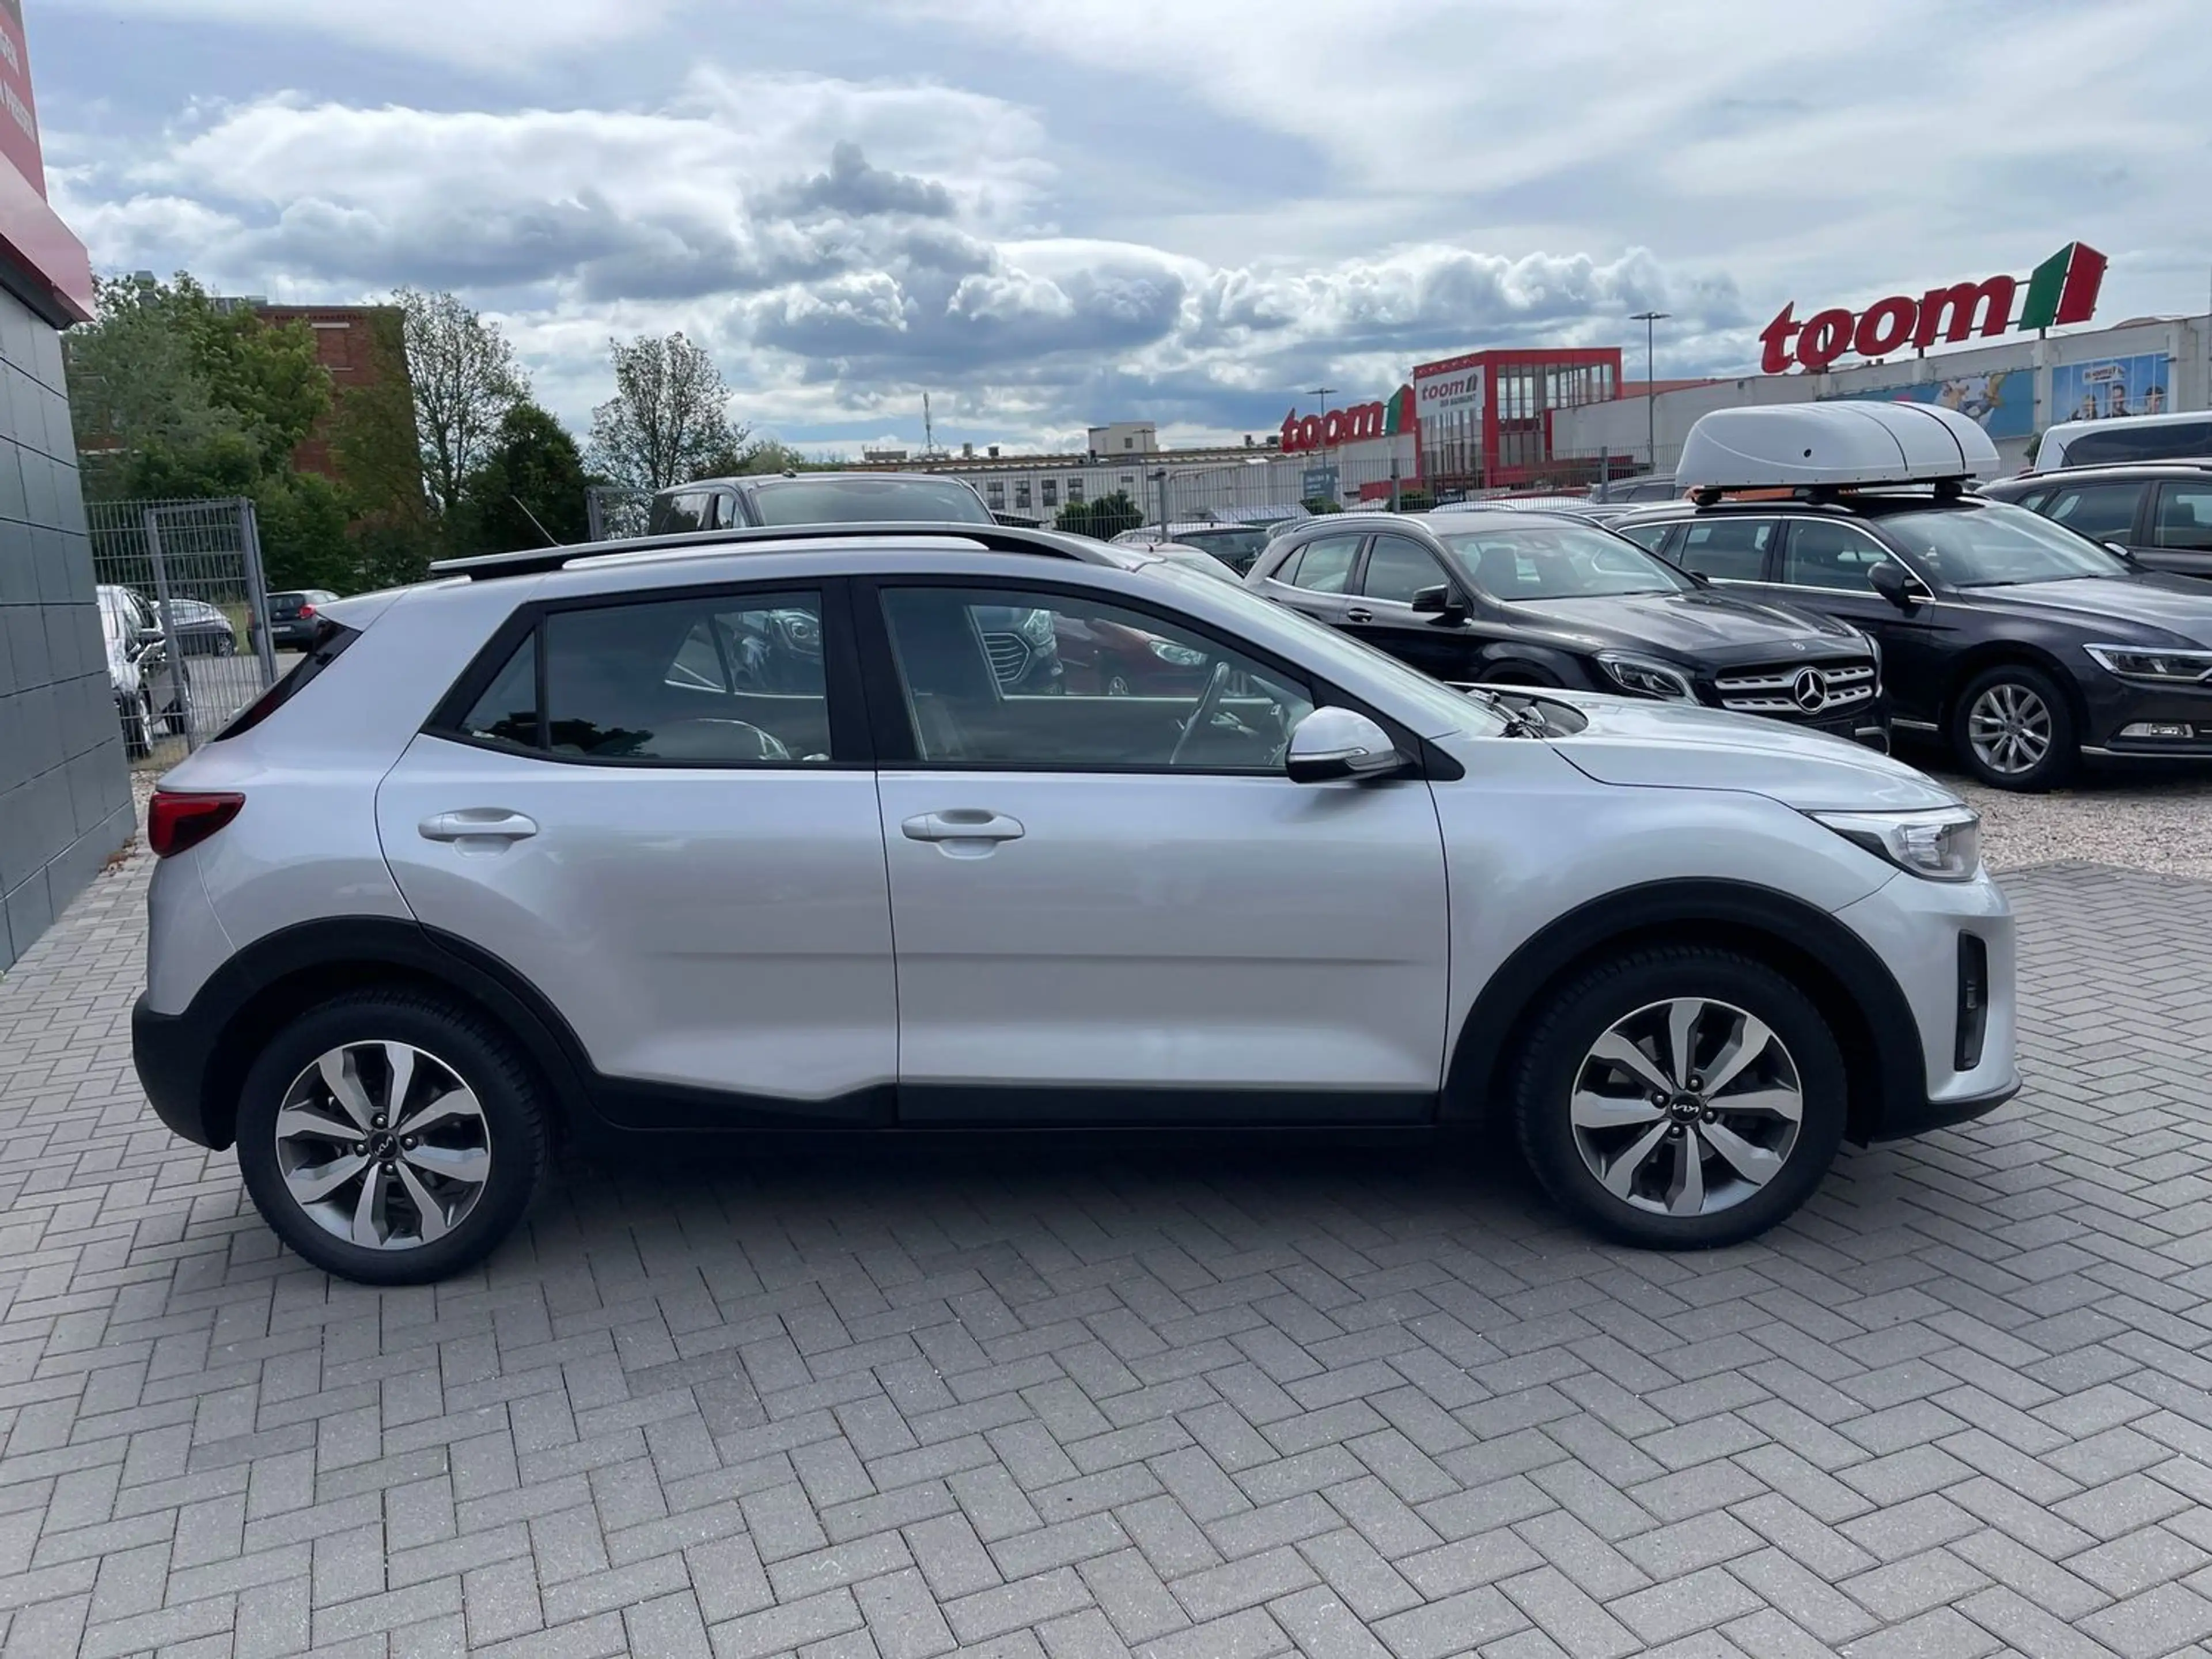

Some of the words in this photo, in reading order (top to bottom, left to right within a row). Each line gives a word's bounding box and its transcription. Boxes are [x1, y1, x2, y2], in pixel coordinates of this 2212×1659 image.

[1759, 275, 2016, 374] toom
[1422, 380, 1464, 402] toom
[1281, 402, 1384, 453] toom
